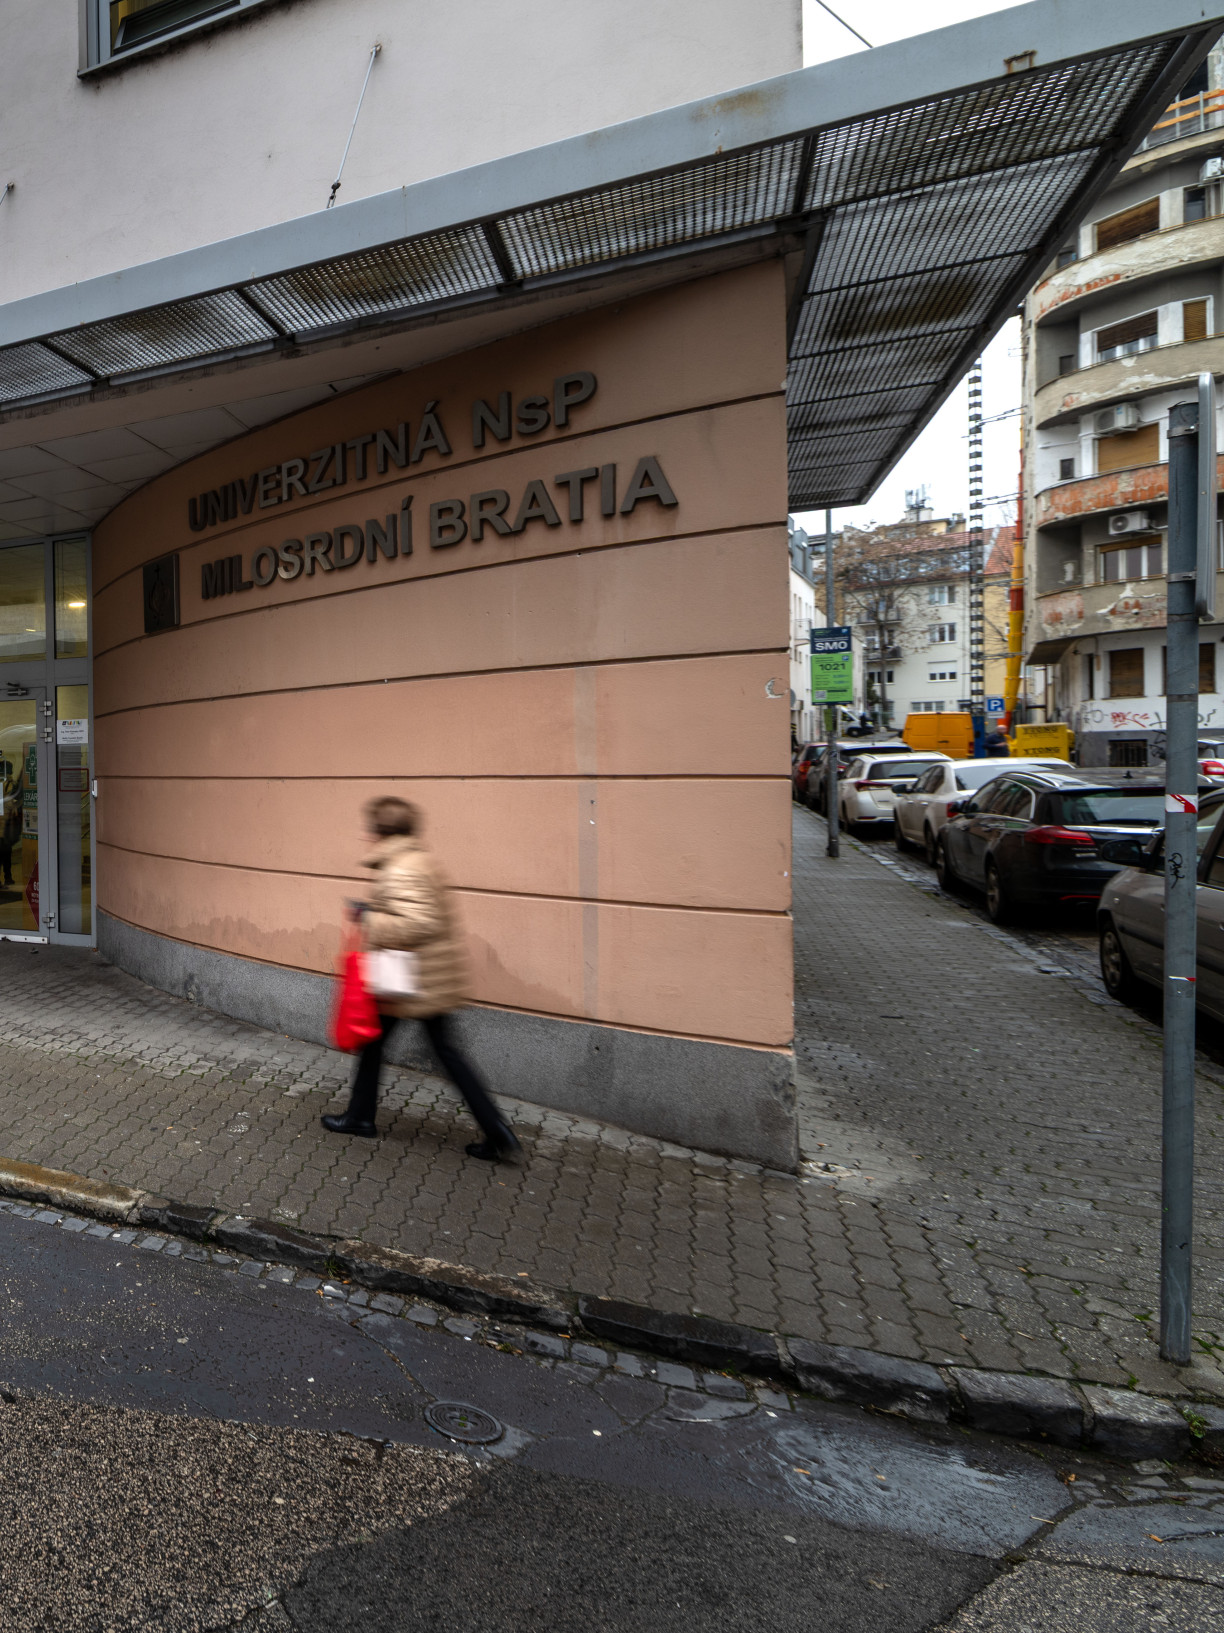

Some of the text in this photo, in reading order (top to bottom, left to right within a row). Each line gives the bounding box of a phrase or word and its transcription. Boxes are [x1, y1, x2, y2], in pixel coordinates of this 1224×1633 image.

[188, 371, 596, 532] UNIVERZITNÁ NsP
[201, 456, 678, 600] MILOSRDNÍ BRATIA
[815, 641, 848, 651] SMO
[818, 663, 846, 671] 1021
[990, 700, 1001, 710] P
